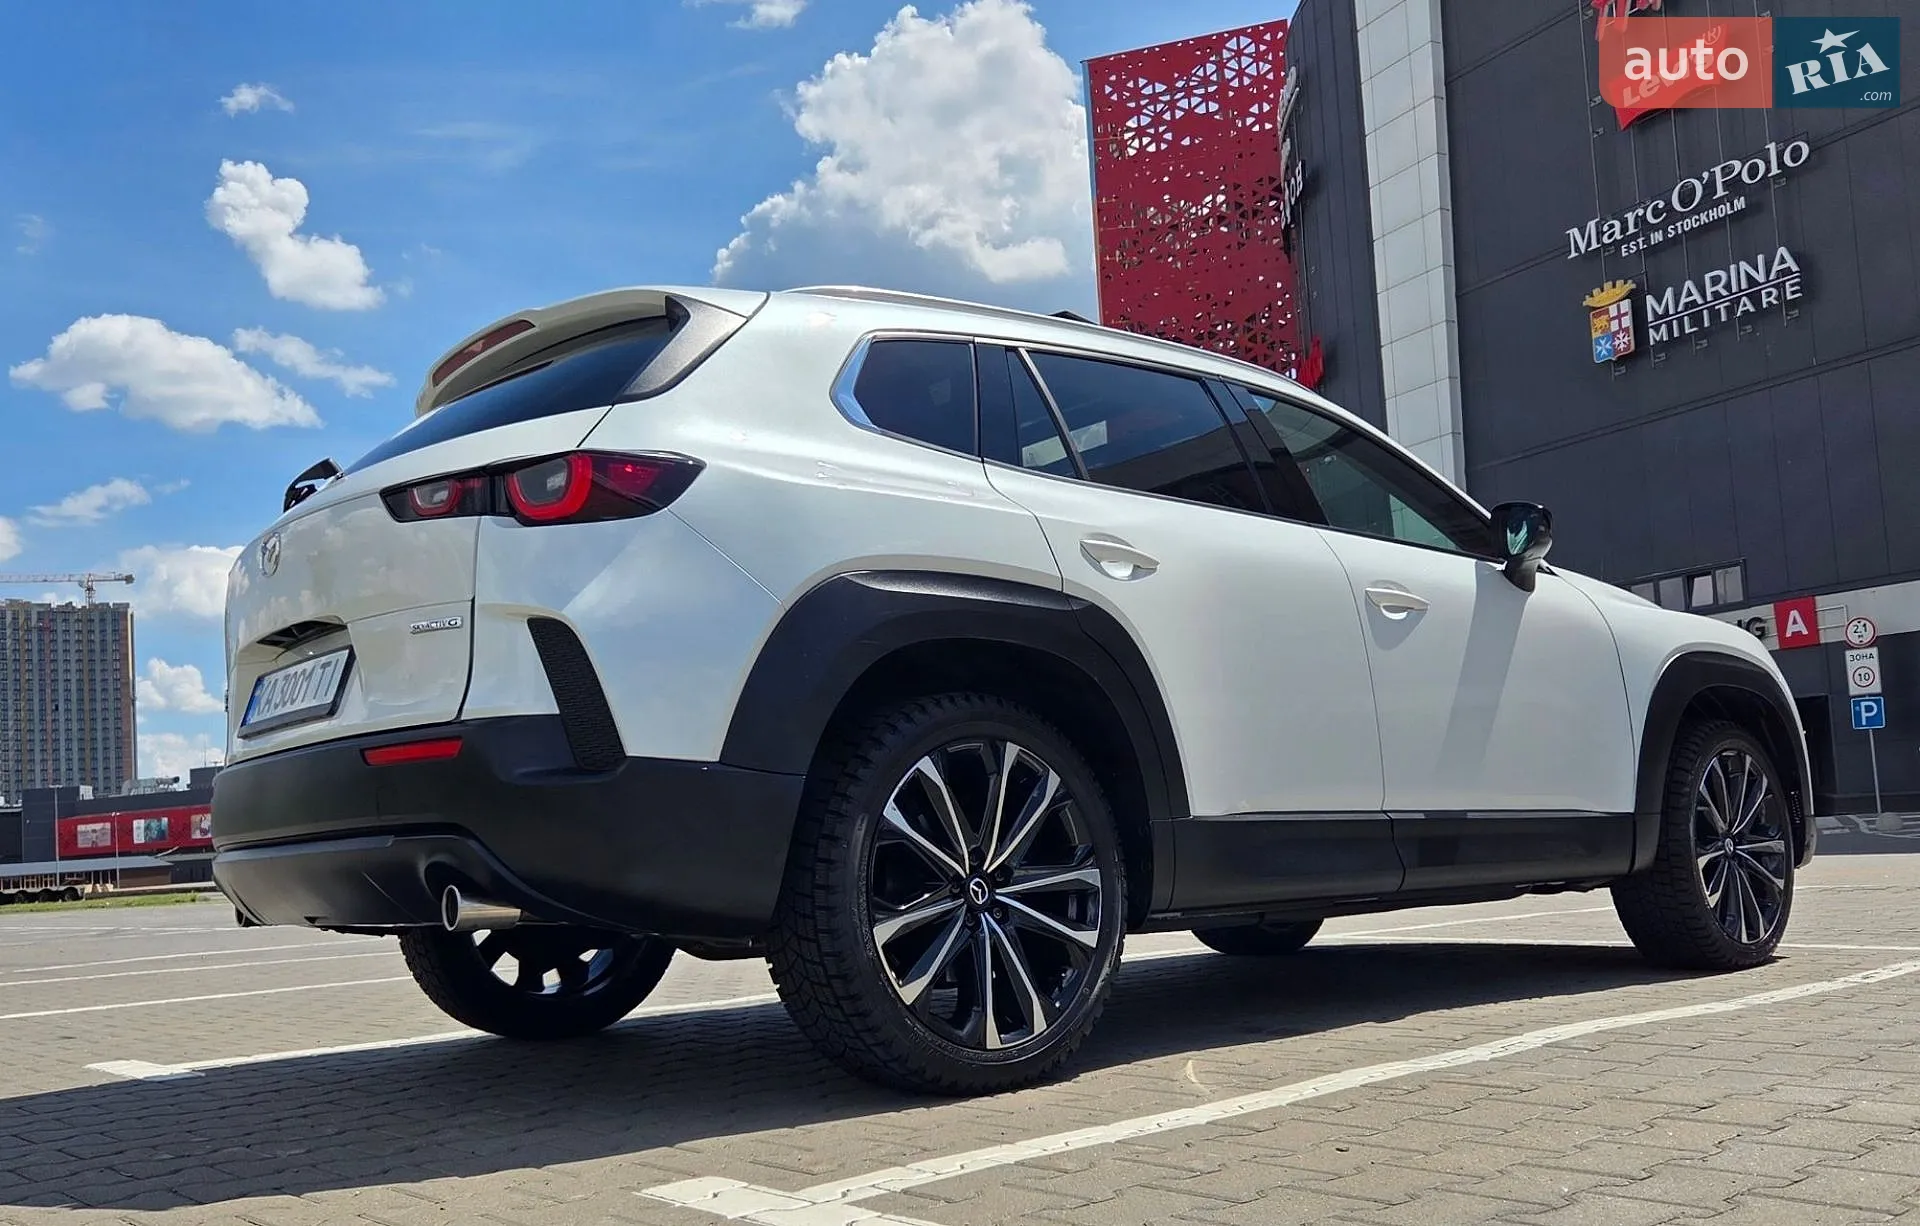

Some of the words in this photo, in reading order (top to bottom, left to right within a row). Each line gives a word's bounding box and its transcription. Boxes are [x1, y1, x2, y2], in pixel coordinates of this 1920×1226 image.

[1565, 199, 1667, 259] Marc
[1671, 140, 1809, 213] O'Polo
[1621, 237, 1648, 257] EST.
[1650, 229, 1663, 245] IN
[1667, 196, 1746, 238] STOCKHOLM
[1646, 246, 1800, 322] MARINA
[1649, 277, 1803, 346] MILITARE
[1785, 609, 1809, 638] A
[1850, 653, 1874, 661] ЗОНА
[1858, 672, 1870, 682] 10
[1860, 701, 1877, 725] P
